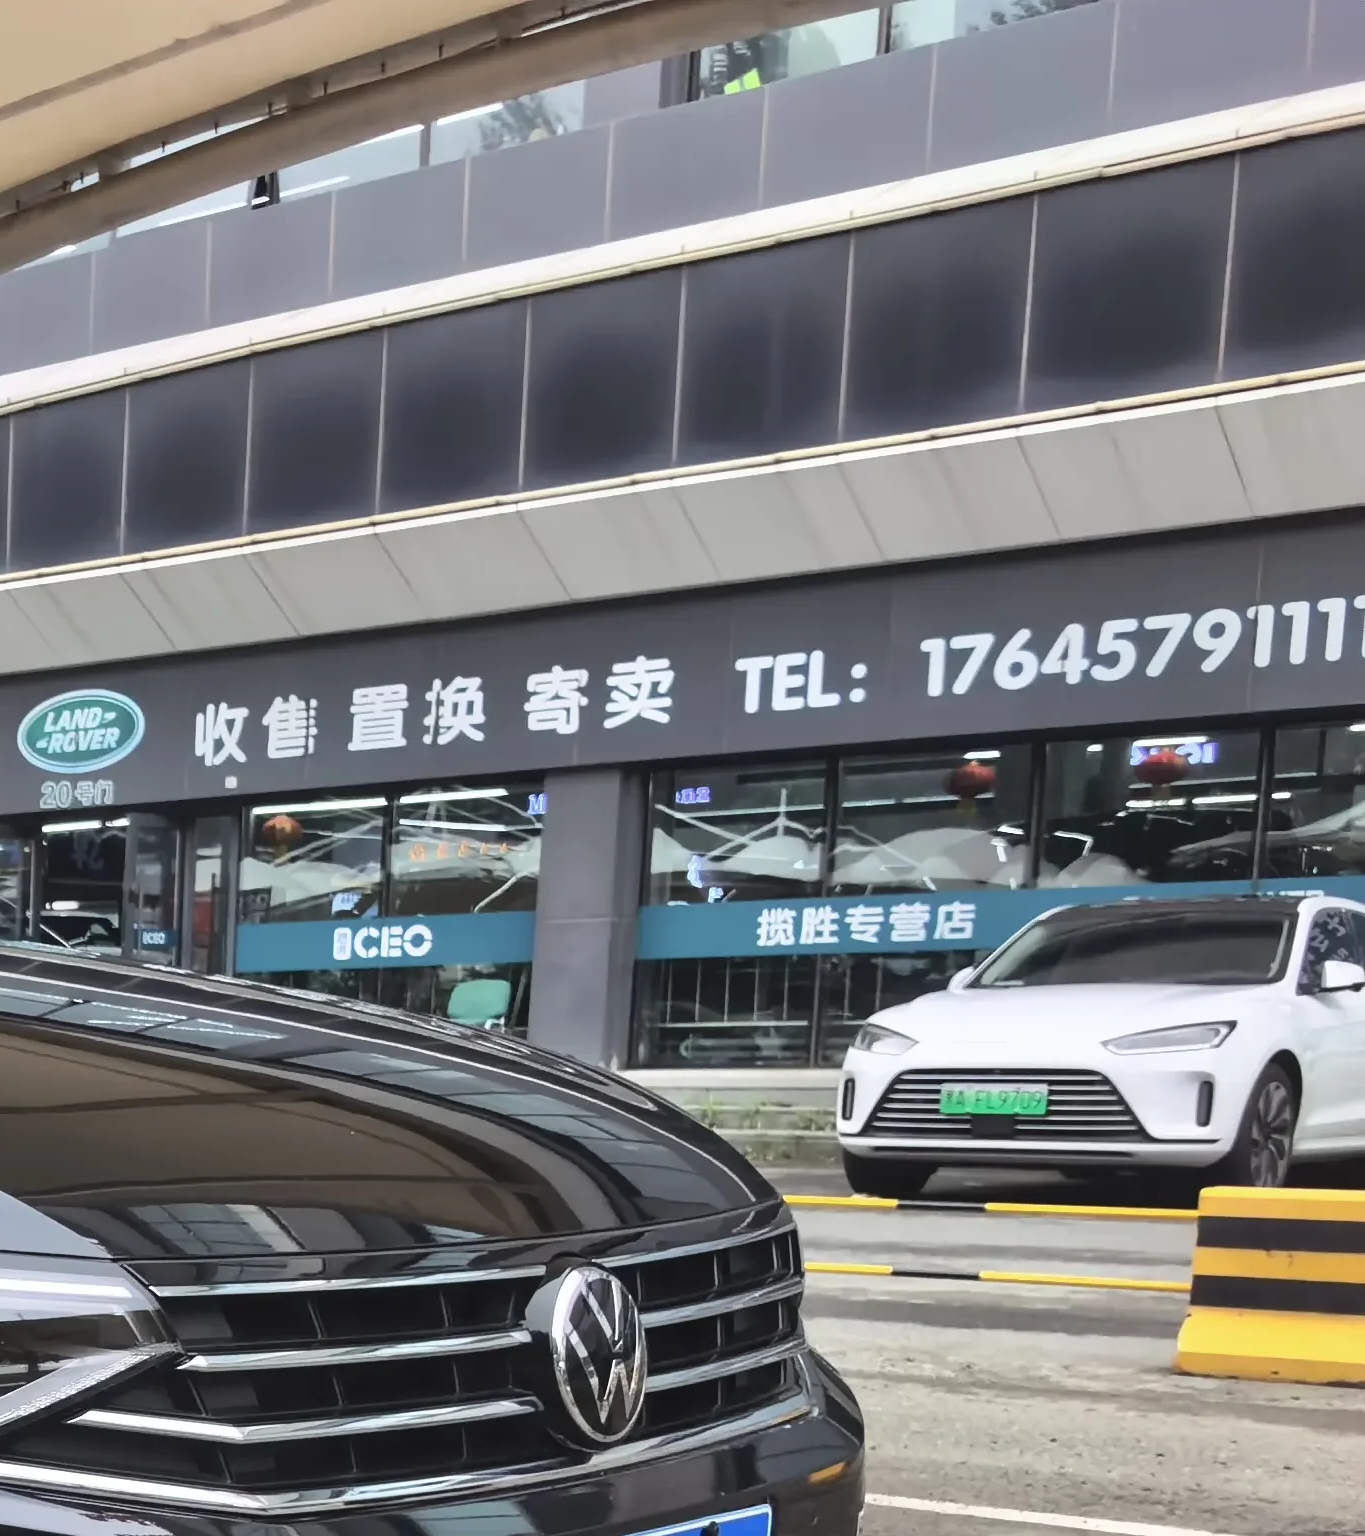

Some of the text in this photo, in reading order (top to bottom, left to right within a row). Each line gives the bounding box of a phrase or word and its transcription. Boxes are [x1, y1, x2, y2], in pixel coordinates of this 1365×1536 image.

[735, 649, 868, 714] TEL:
[44, 707, 103, 733] LAND
[195, 655, 676, 767] 收售 置换 寄卖
[47, 727, 121, 754] ROVER
[756, 901, 977, 947] 揽胜专营店
